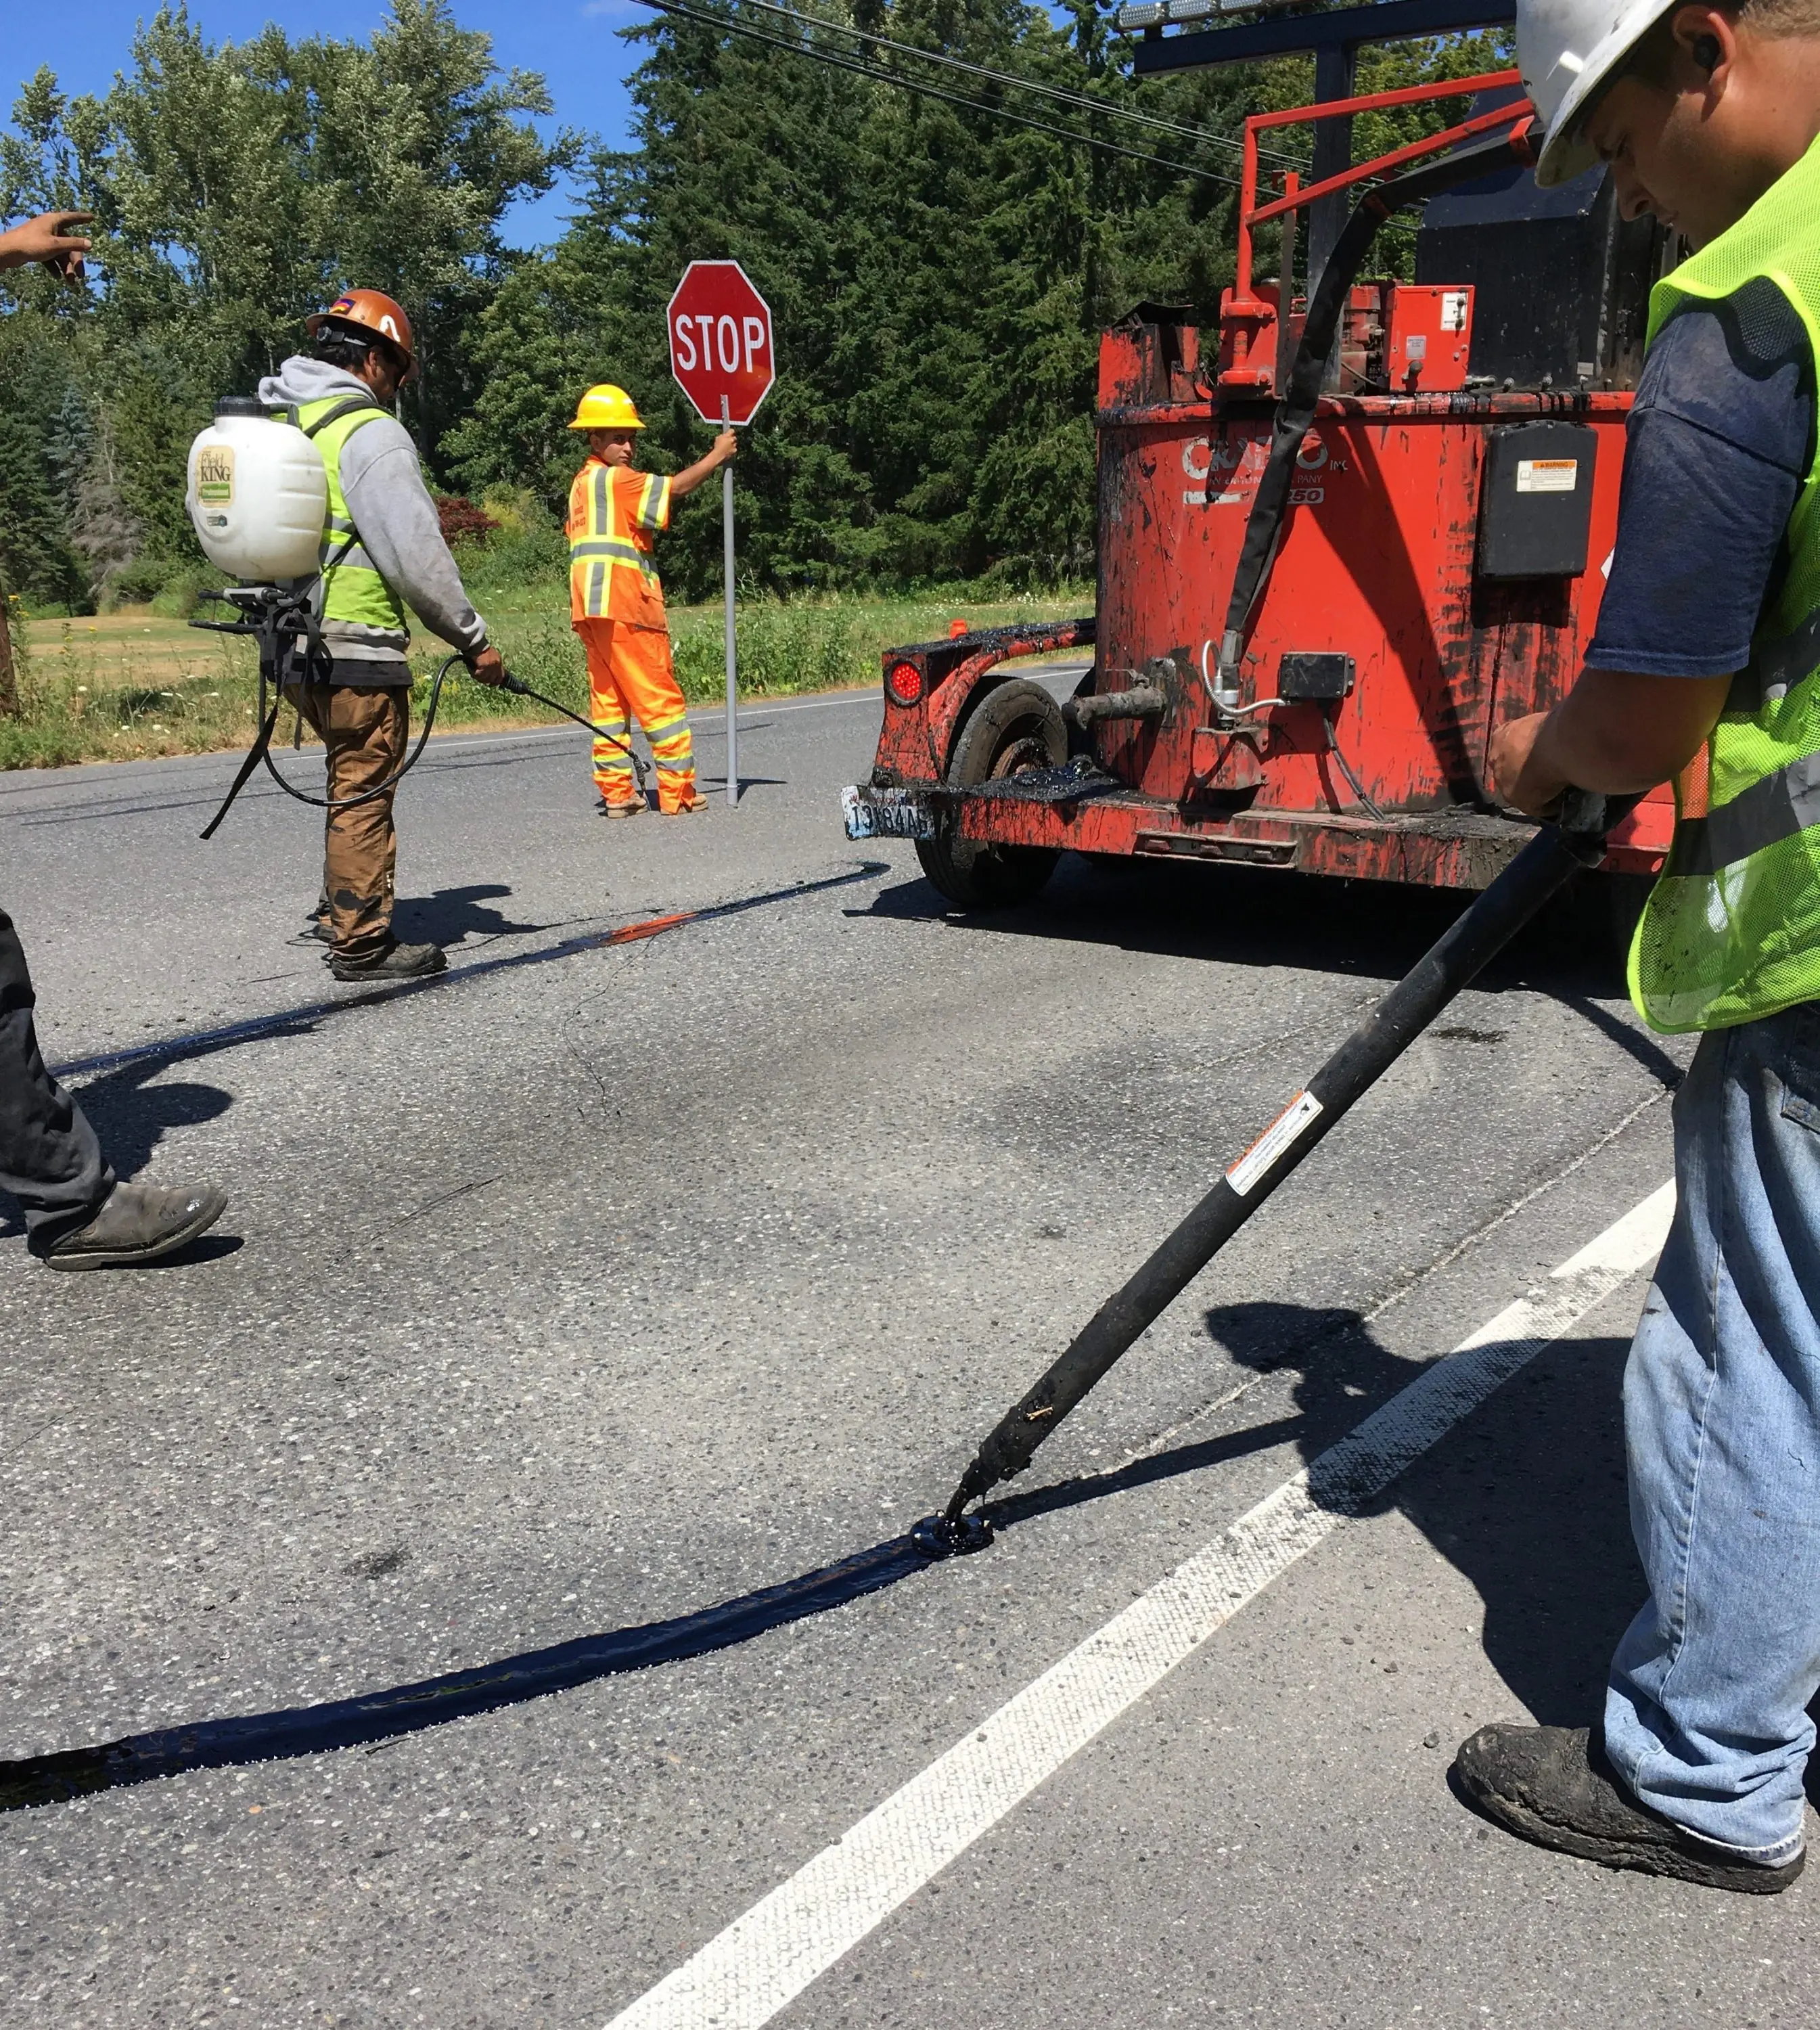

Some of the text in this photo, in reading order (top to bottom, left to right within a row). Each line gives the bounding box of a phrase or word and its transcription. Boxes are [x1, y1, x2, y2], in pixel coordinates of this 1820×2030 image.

[675, 314, 765, 373] STOP
[201, 453, 224, 468] Field
[200, 466, 231, 482] KING
